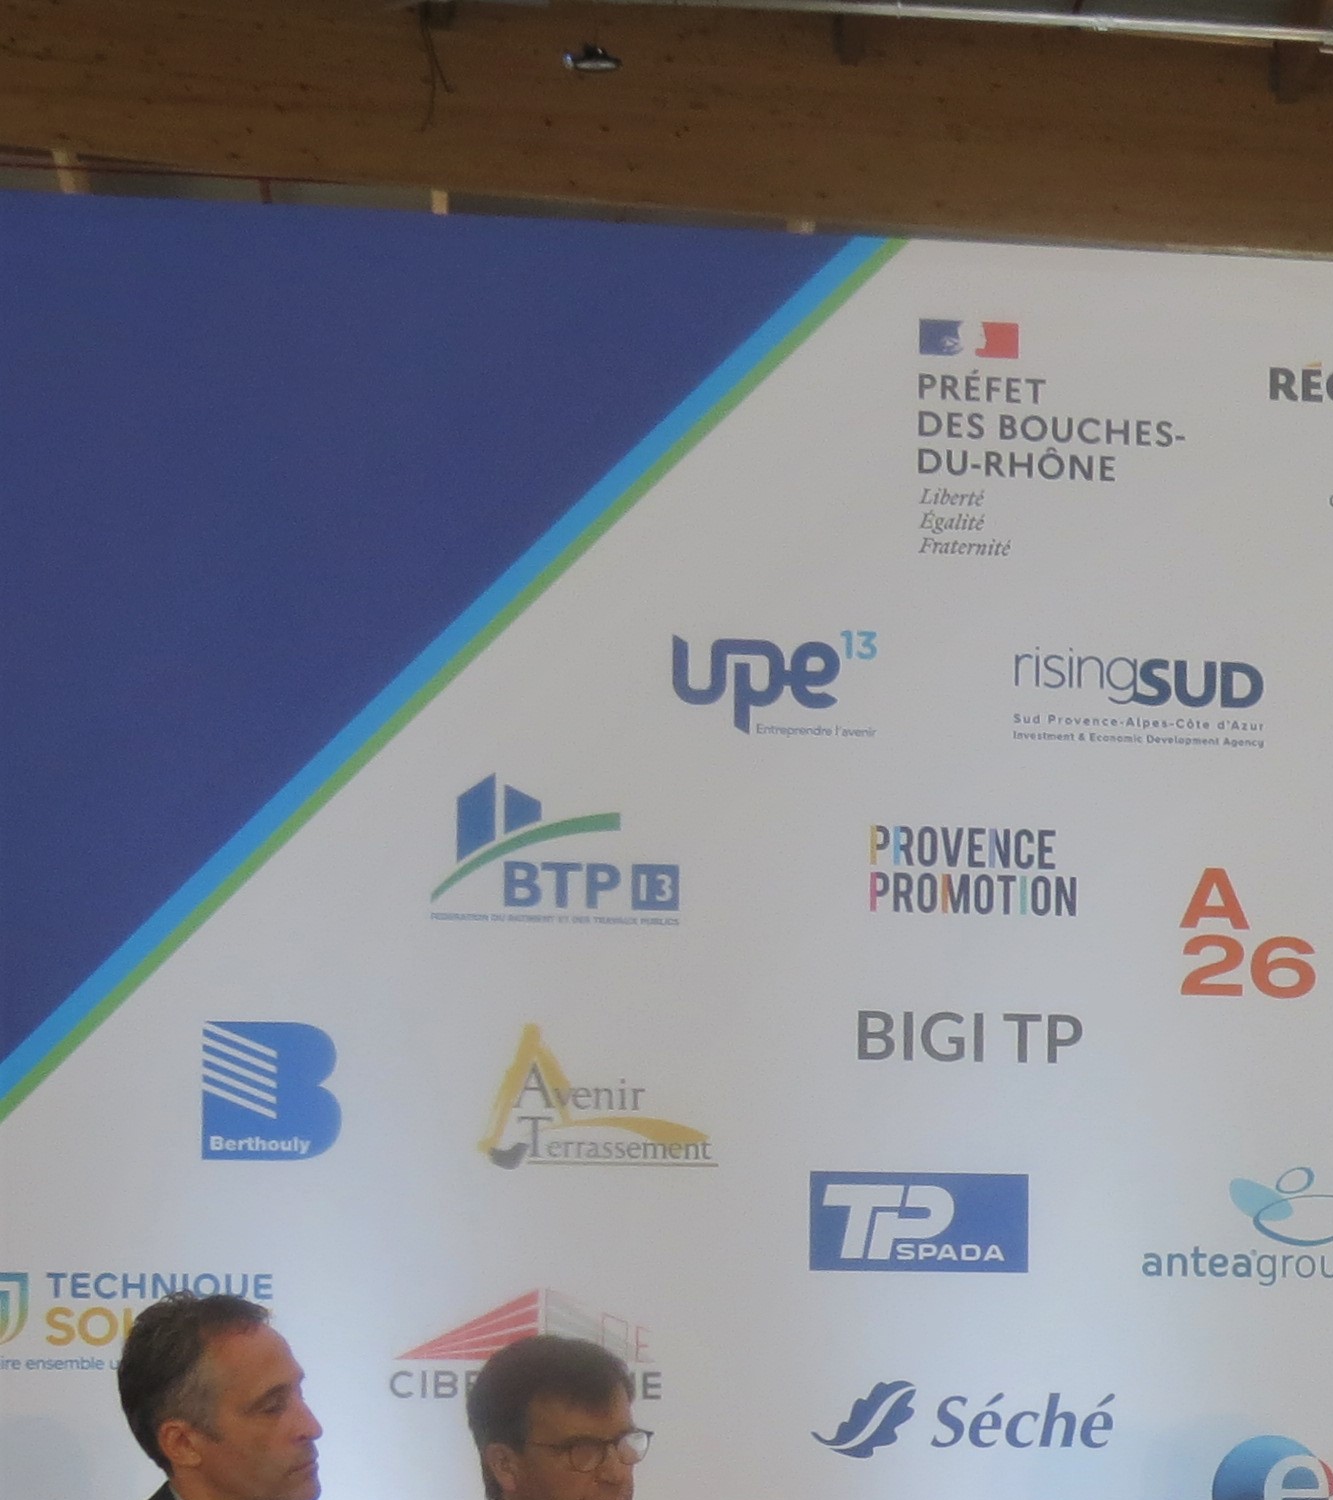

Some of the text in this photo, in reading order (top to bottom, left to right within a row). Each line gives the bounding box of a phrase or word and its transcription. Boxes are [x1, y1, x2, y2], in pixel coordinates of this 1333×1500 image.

[917, 370, 1047, 404] PRÉFET
[917, 410, 1187, 448] DES BOUCHES-
[916, 445, 1118, 483] DU-RHÔNE
[919, 487, 985, 508] Liberté
[919, 511, 985, 535] Égalité
[917, 537, 1012, 557] Fraternité
[672, 630, 877, 734] upe 13
[756, 724, 832, 738] Entreprendre
[1013, 731, 1264, 748] Investment & Economic Development Agency
[1014, 714, 1264, 731] Sud Provence-Alpes-Côte d'Azur
[869, 824, 1056, 870] PROVENCE
[504, 861, 672, 909] BTP 13
[869, 872, 1078, 918] PROMOTION
[1179, 867, 1250, 929] A
[1181, 934, 1316, 999] 26
[857, 1010, 1083, 1064] BIGI TP
[512, 1060, 645, 1112] Avenir
[209, 1135, 311, 1155] Berthouly
[519, 1115, 711, 1161] Terrassement
[822, 1184, 955, 1261] TP
[895, 1243, 1005, 1262] SPADA
[46, 1273, 273, 1300] TECHNIQUE
[26, 1357, 104, 1371] ensemble
[930, 1392, 1115, 1449] Séché
